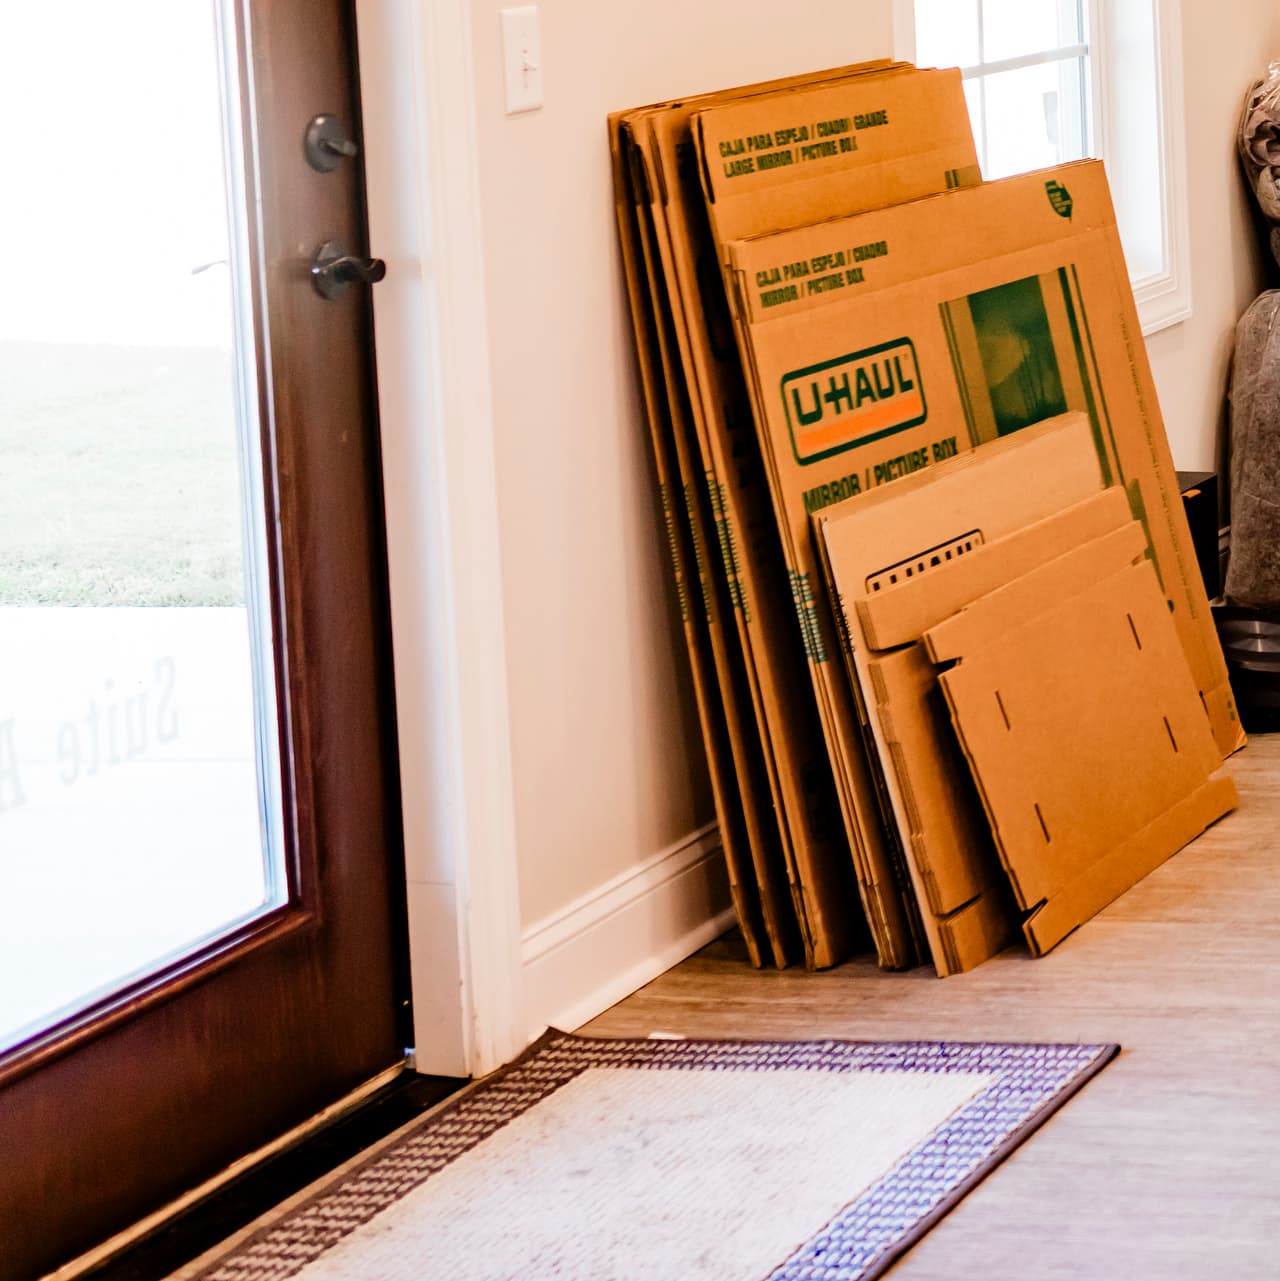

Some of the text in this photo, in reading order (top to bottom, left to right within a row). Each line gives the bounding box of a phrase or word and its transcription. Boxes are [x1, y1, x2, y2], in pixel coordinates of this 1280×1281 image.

[718, 110, 889, 158] CAJA PARA ESPEJO GRANDE
[723, 140, 838, 178] LARGE MIRROR PICTURE
[756, 268, 782, 288] CAJA
[782, 261, 810, 281] PARA
[811, 251, 846, 274] ESPEJO
[807, 272, 845, 296] PICTURE
[792, 355, 913, 426] U-HAUL
[802, 436, 959, 515] MIRROR PICTURE BOX
